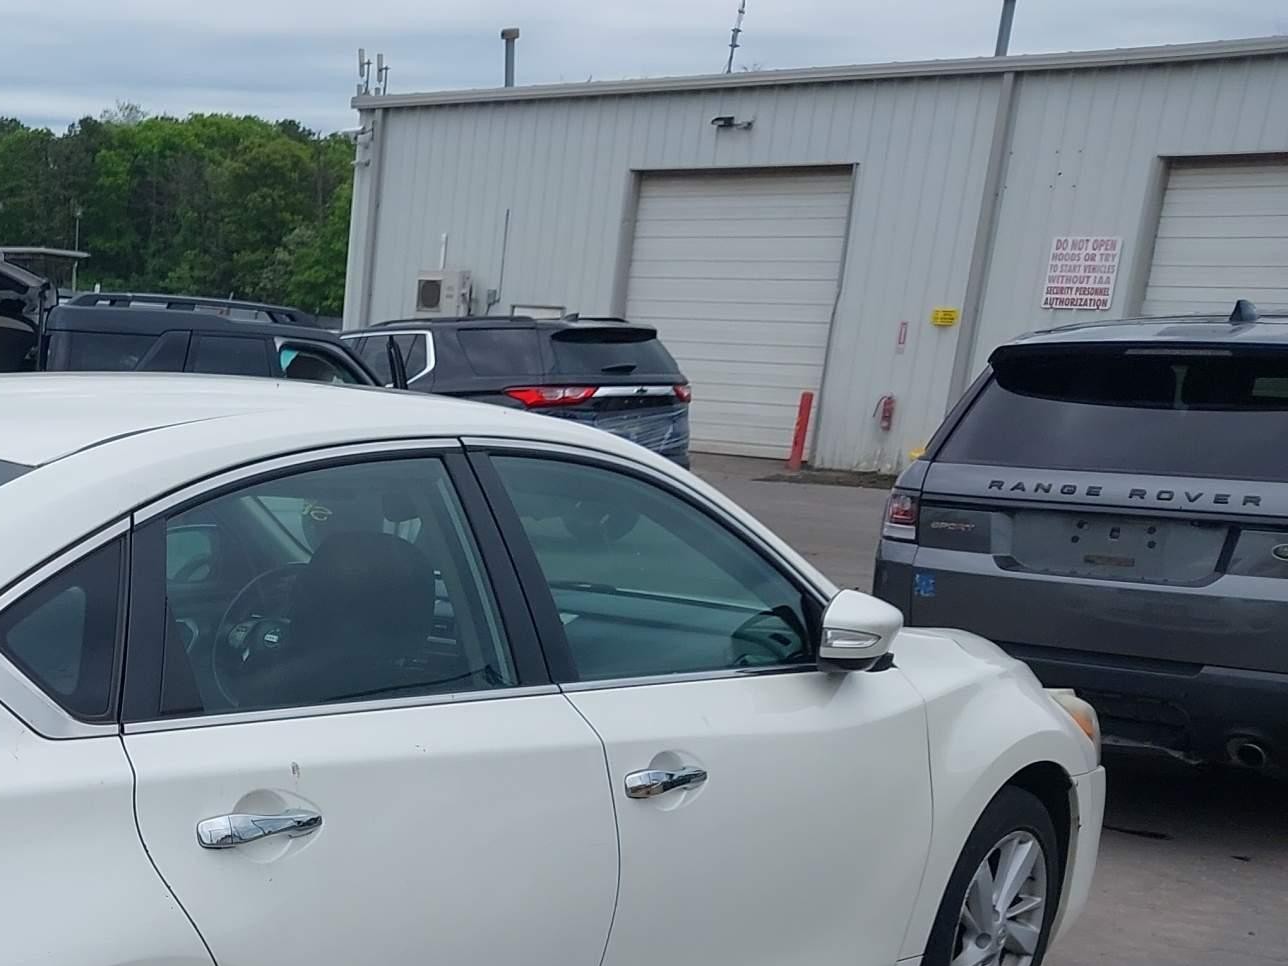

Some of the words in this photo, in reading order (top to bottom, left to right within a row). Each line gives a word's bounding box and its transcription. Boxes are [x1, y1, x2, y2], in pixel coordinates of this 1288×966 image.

[1056, 239, 1069, 251] DO
[1071, 239, 1090, 251] NOT
[1092, 239, 1116, 251] OPEN
[1052, 253, 1081, 262] HOODS
[1084, 253, 1097, 262] OR
[1099, 253, 1117, 263] TRY
[1049, 264, 1059, 273] TO
[1060, 264, 1081, 273] START
[1083, 265, 1116, 274] VEHICLES
[1048, 275, 1091, 284] WITHOUT
[1093, 276, 1110, 284] IAA
[1046, 286, 1074, 295] SECURITY
[1075, 287, 1109, 296] PERSONNEL
[1043, 297, 1108, 307] AUTHORIZATION
[987, 479, 1103, 498] RANGE
[1128, 488, 1263, 508] ROVER
